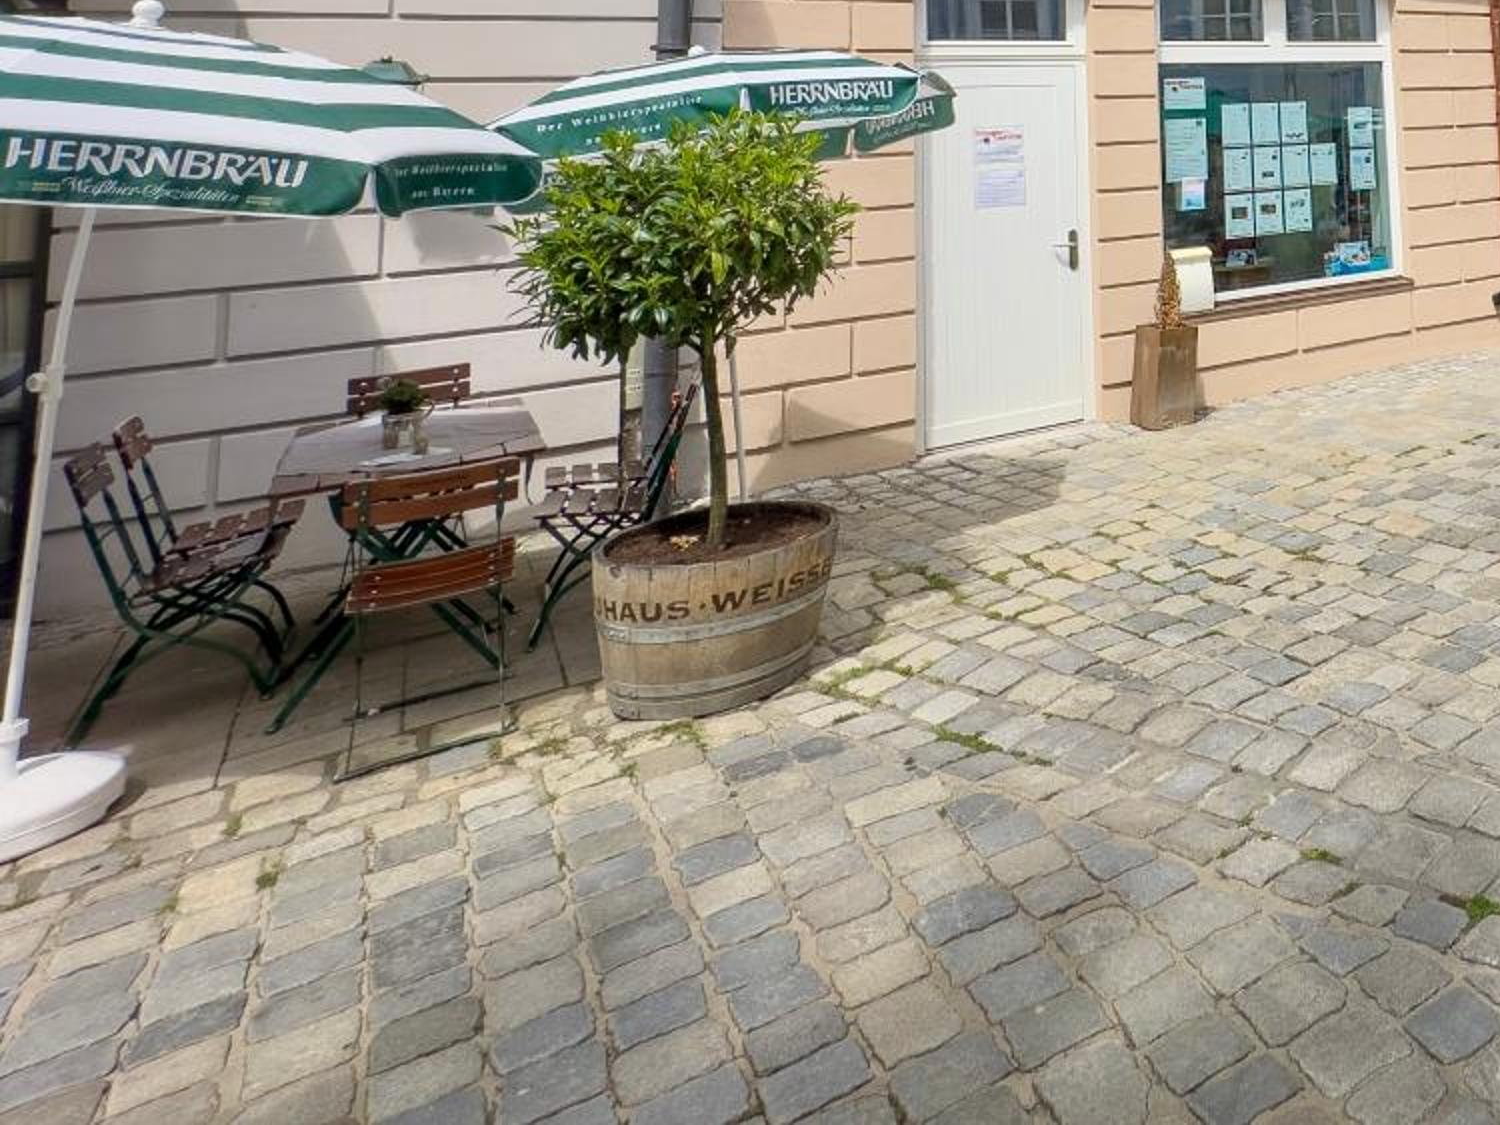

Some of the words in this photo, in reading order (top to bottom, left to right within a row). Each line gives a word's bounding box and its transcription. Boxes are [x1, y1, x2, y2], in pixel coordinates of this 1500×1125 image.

[768, 80, 894, 106] HERRNBRÄU
[536, 122, 563, 134] Der
[4, 136, 310, 188] HERRNBRÄU
